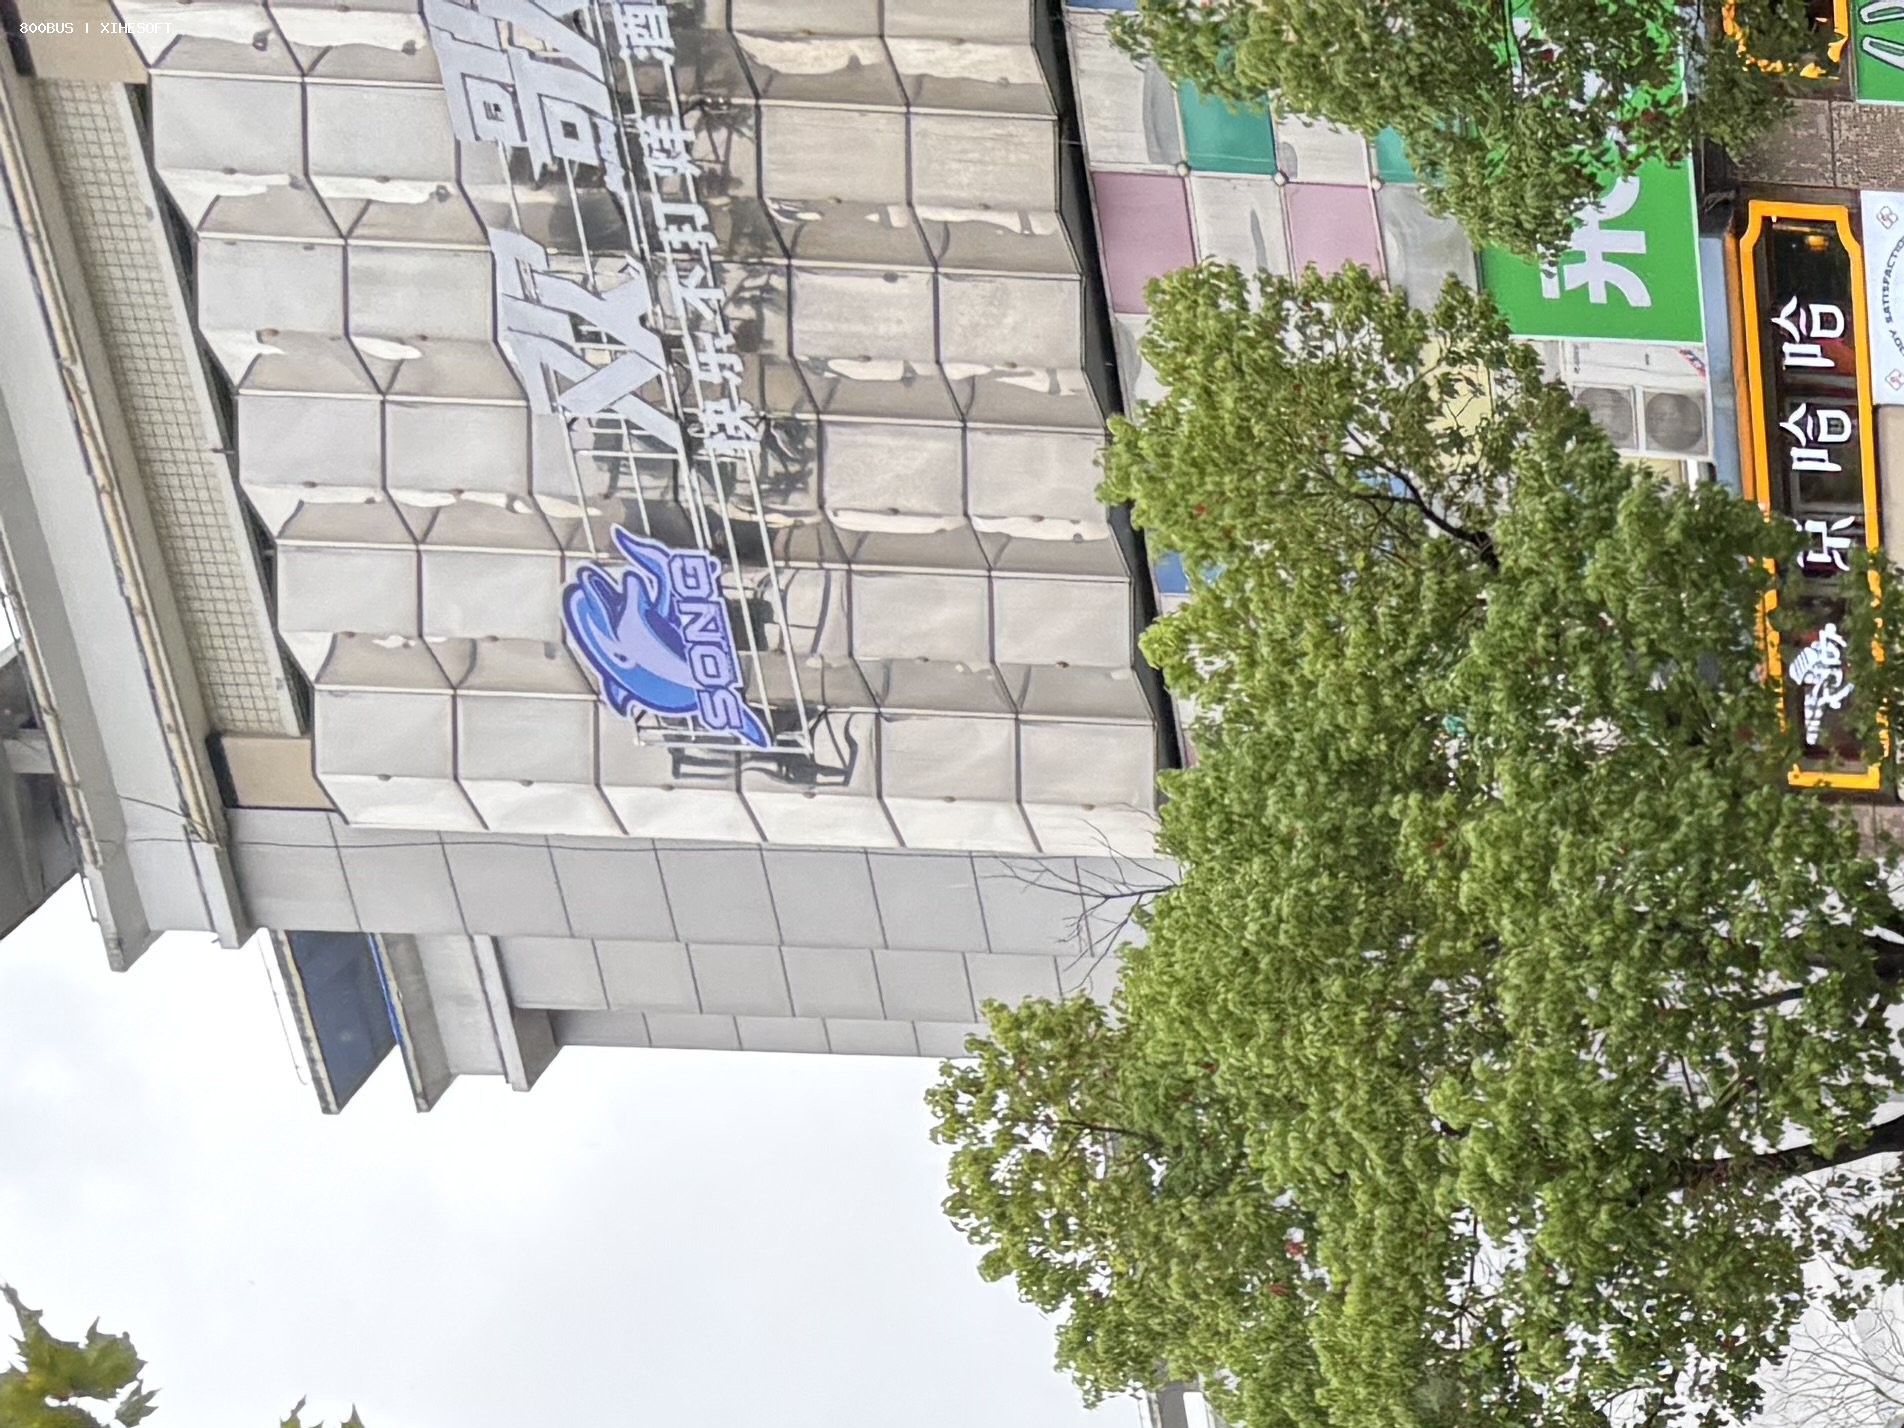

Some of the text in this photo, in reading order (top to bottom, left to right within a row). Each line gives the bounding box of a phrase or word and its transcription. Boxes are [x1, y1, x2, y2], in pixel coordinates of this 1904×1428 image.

[636, 114, 761, 453] 快乐不打烊
[1771, 295, 1856, 572] 京哈哈
[667, 553, 744, 731] SONG
